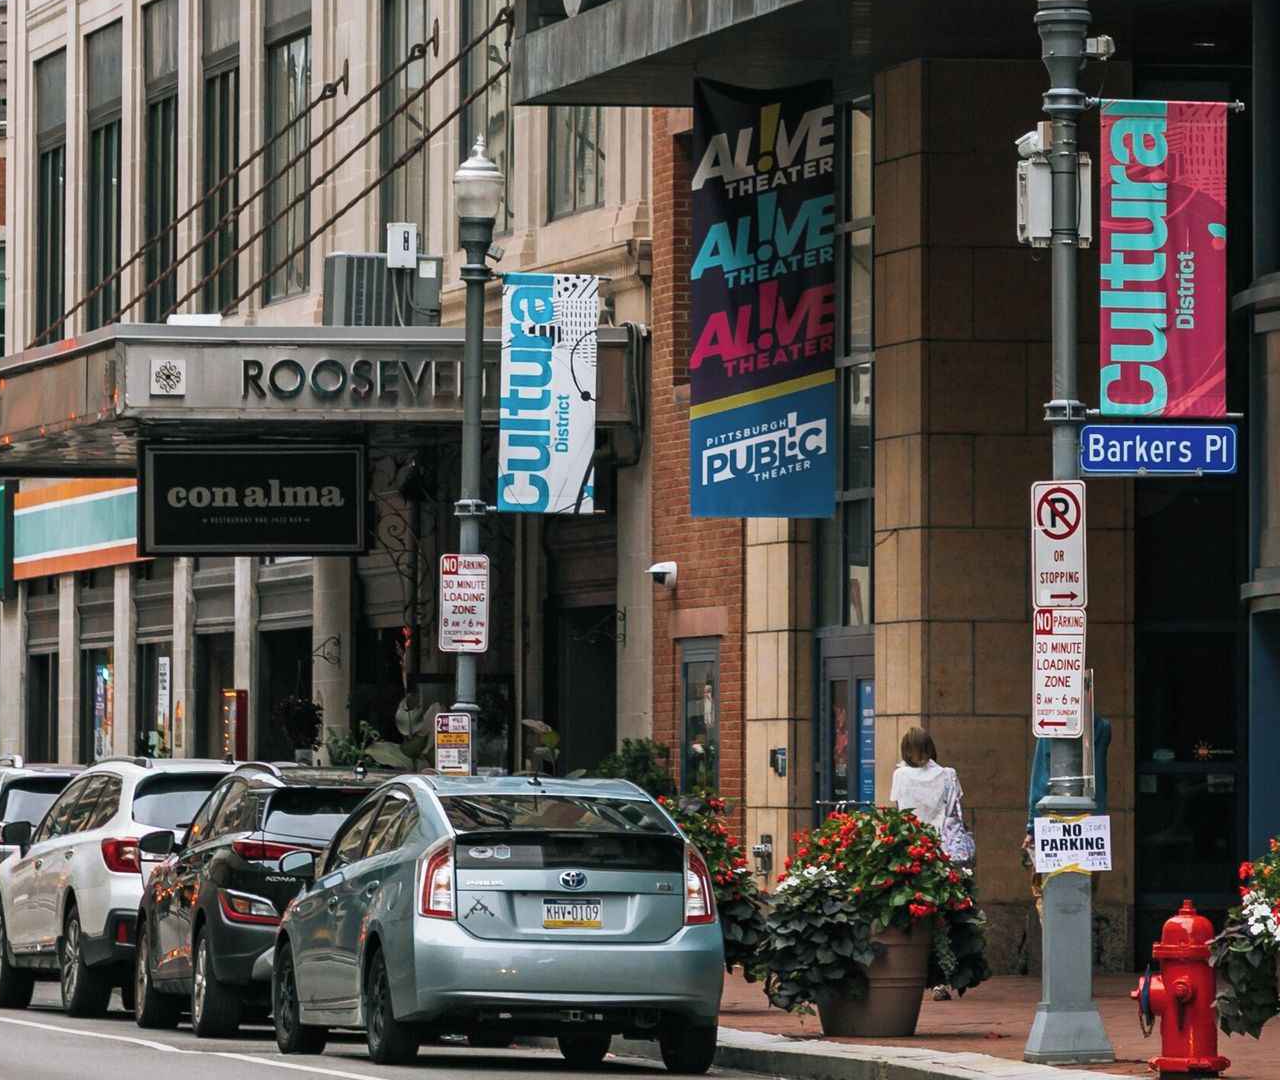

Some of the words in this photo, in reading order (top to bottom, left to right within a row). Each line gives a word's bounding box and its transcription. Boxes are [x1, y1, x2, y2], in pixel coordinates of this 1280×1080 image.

[725, 157, 833, 199] THEATER
[1100, 99, 1168, 417] Cultural
[724, 246, 833, 289] THEATER
[1176, 251, 1195, 330] District
[723, 336, 833, 377] THEATER
[498, 273, 556, 513] Cultural
[555, 394, 570, 453] District
[706, 418, 787, 447] PITTSBURGH
[1089, 433, 1193, 464] Barkers
[1206, 434, 1228, 463] Pl
[754, 460, 812, 482] THEATER
[167, 485, 239, 508] con
[244, 479, 345, 508] alma
[1053, 550, 1065, 562] OR
[443, 558, 457, 572] NO
[458, 560, 487, 570] PARKING
[443, 580, 454, 590] 30
[457, 580, 486, 590] MINUTE
[1040, 572, 1079, 584] STOPPING
[443, 592, 486, 603] LOADING
[451, 605, 477, 615] ZONE
[1036, 612, 1051, 631] NO
[1053, 616, 1083, 628] PARKING
[1036, 642, 1048, 654] 30
[1051, 642, 1082, 654] MINUTE
[1037, 659, 1081, 671] LOADING
[1044, 676, 1071, 688] ZONE
[1036, 693, 1042, 705] 8
[1044, 696, 1053, 705] AM
[1062, 694, 1068, 705] 6
[1071, 696, 1080, 705] PM
[1062, 824, 1082, 838] NO
[1041, 837, 1105, 852] PARKING
